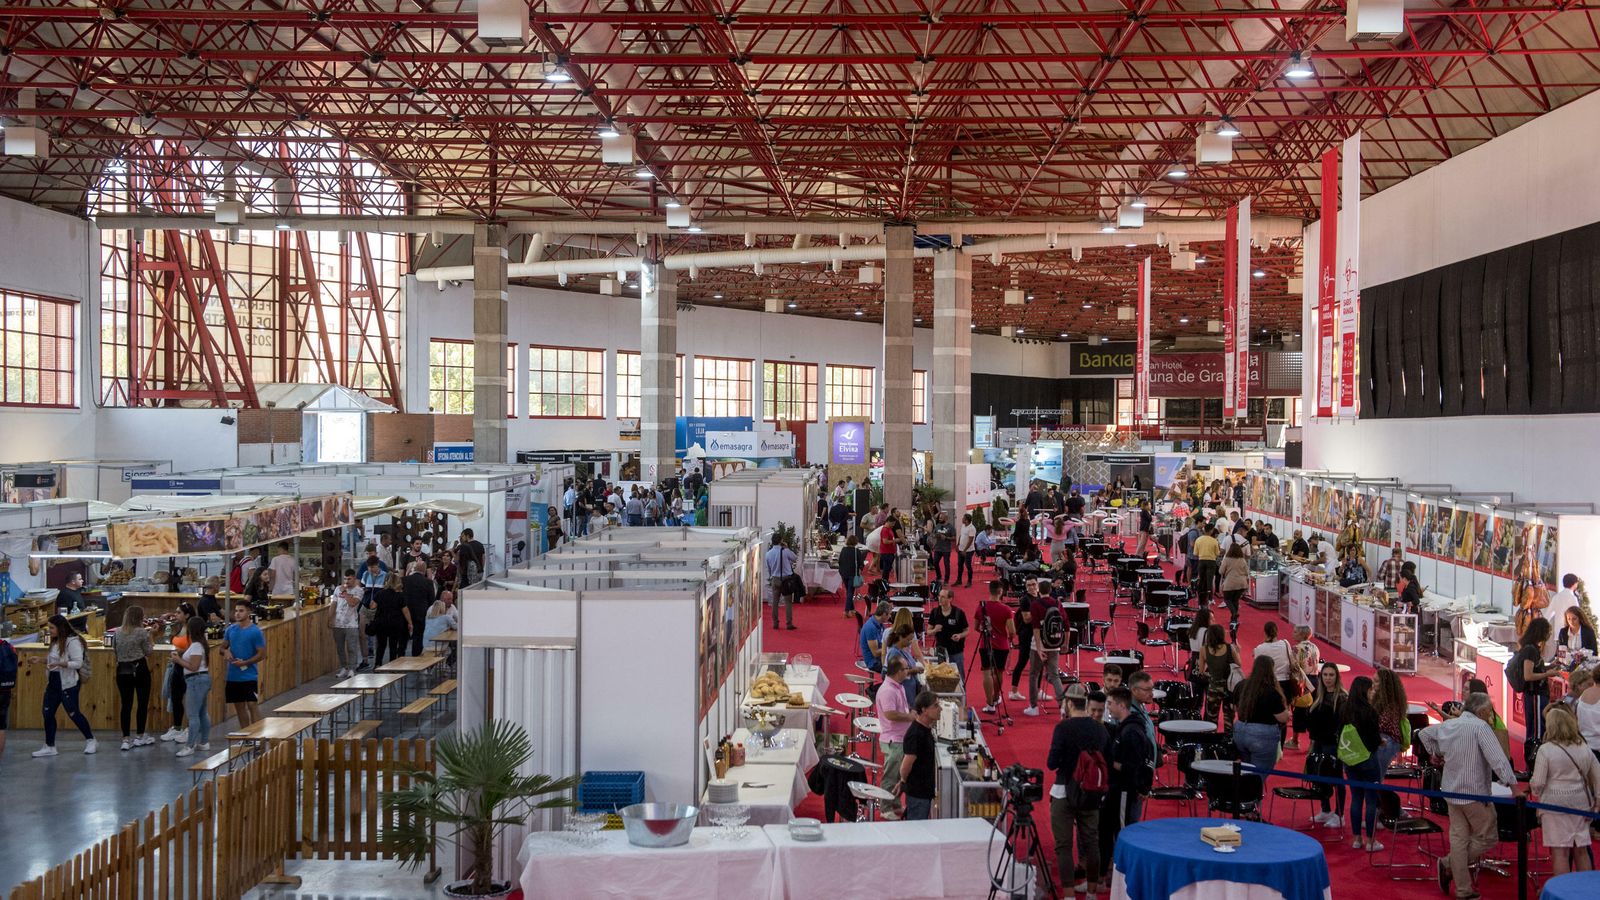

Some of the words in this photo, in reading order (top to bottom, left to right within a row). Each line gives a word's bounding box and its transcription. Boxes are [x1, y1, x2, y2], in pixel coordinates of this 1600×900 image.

[1079, 352, 1134, 368] Bankia
[1162, 361, 1183, 370] Hotel
[1149, 372, 1173, 382] una
[1177, 370, 1195, 382] de
[1199, 369, 1259, 383] Graa
[720, 443, 753, 451] emasagra
[767, 442, 790, 451] emasagra
